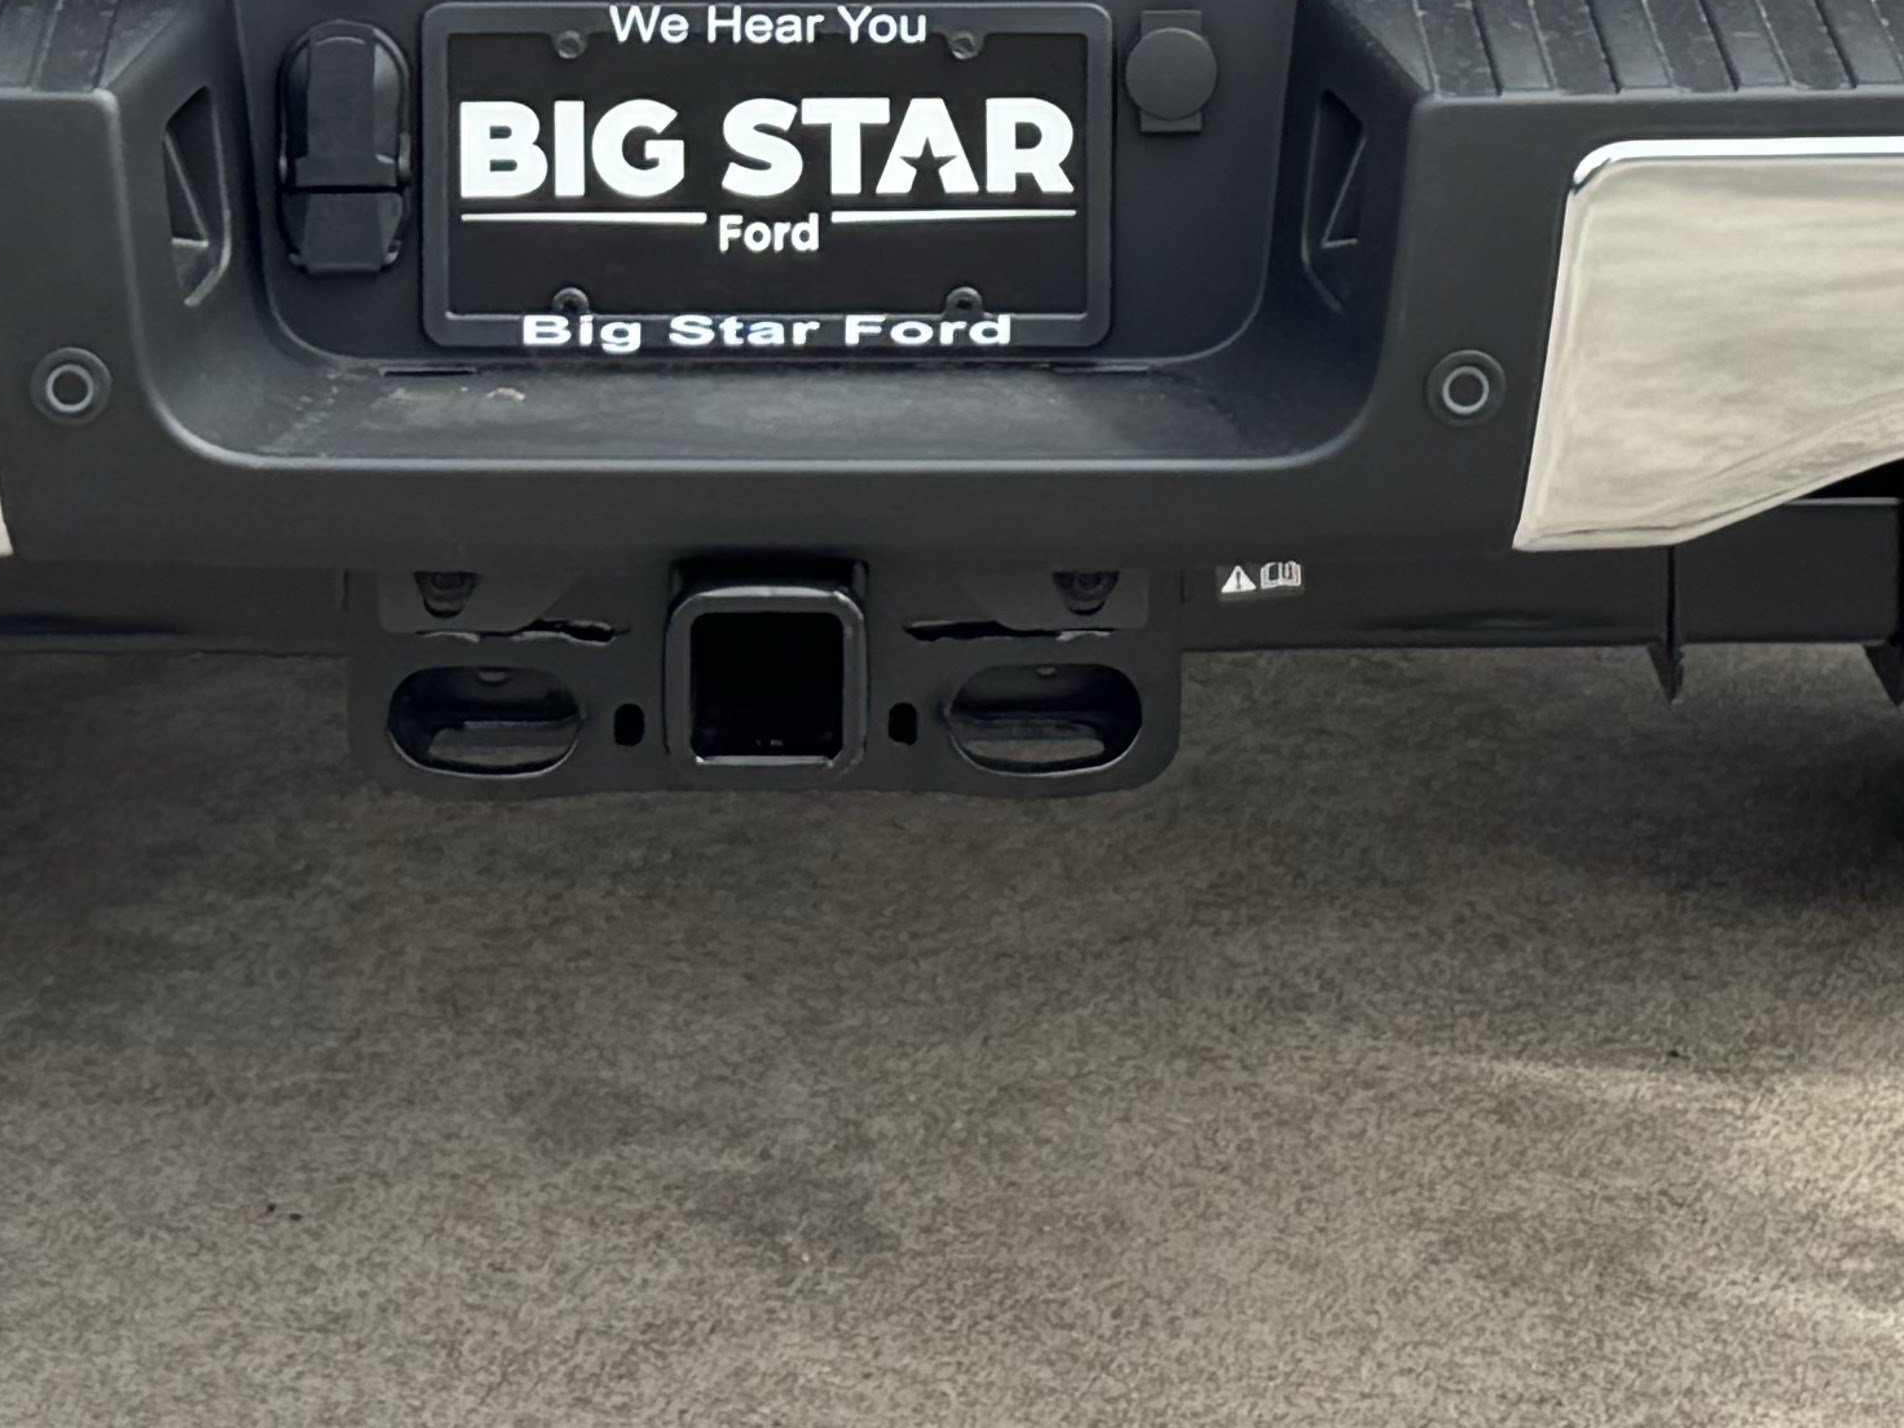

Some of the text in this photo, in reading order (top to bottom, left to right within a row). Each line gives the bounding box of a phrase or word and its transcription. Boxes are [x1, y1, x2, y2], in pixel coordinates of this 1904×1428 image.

[608, 4, 928, 45] We Hear You
[458, 96, 1077, 200] BIG STAR
[717, 213, 820, 253] Ford
[521, 313, 1013, 354] Big Star Ford
